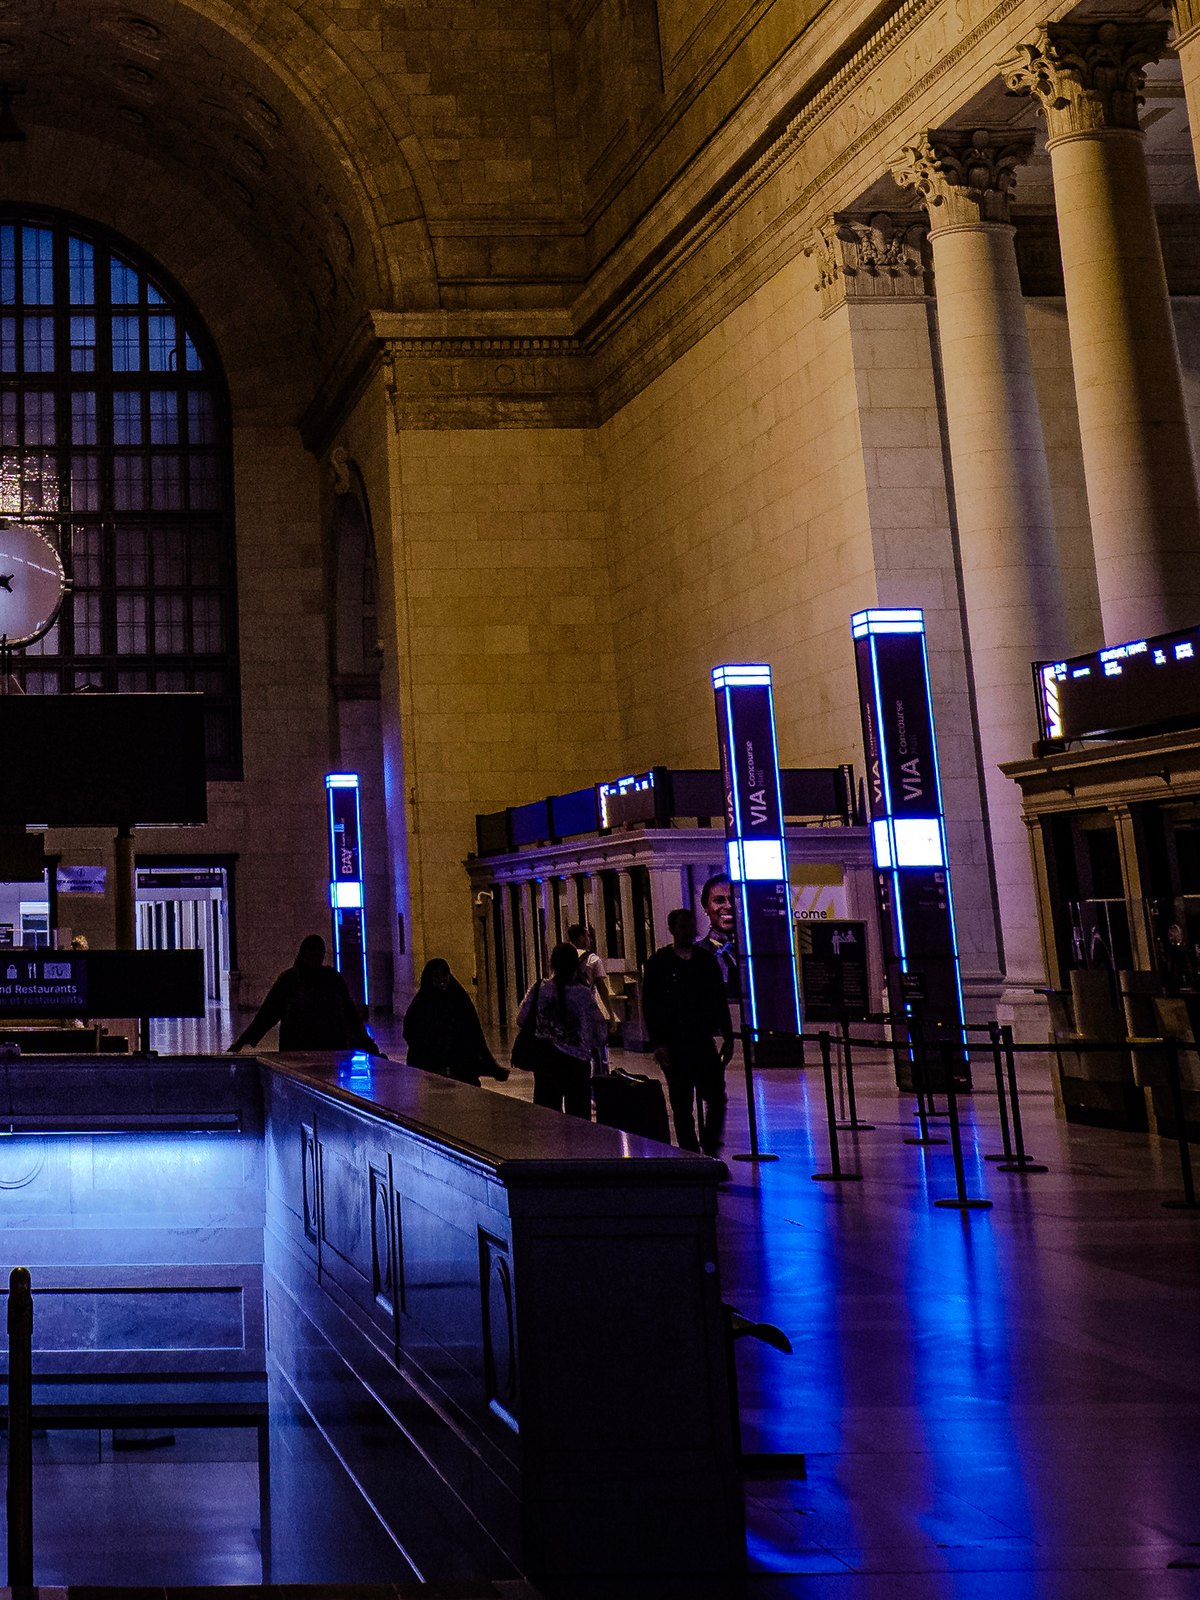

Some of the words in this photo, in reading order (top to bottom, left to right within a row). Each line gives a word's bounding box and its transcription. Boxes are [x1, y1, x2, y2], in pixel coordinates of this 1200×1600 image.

[896, 699, 908, 755] Concourse
[745, 740, 756, 787] Concourse
[901, 757, 923, 801] VIA
[749, 788, 768, 826] VIA
[341, 847, 353, 874] BAY
[794, 910, 828, 919] come
[15, 984, 78, 994] Restaurants
